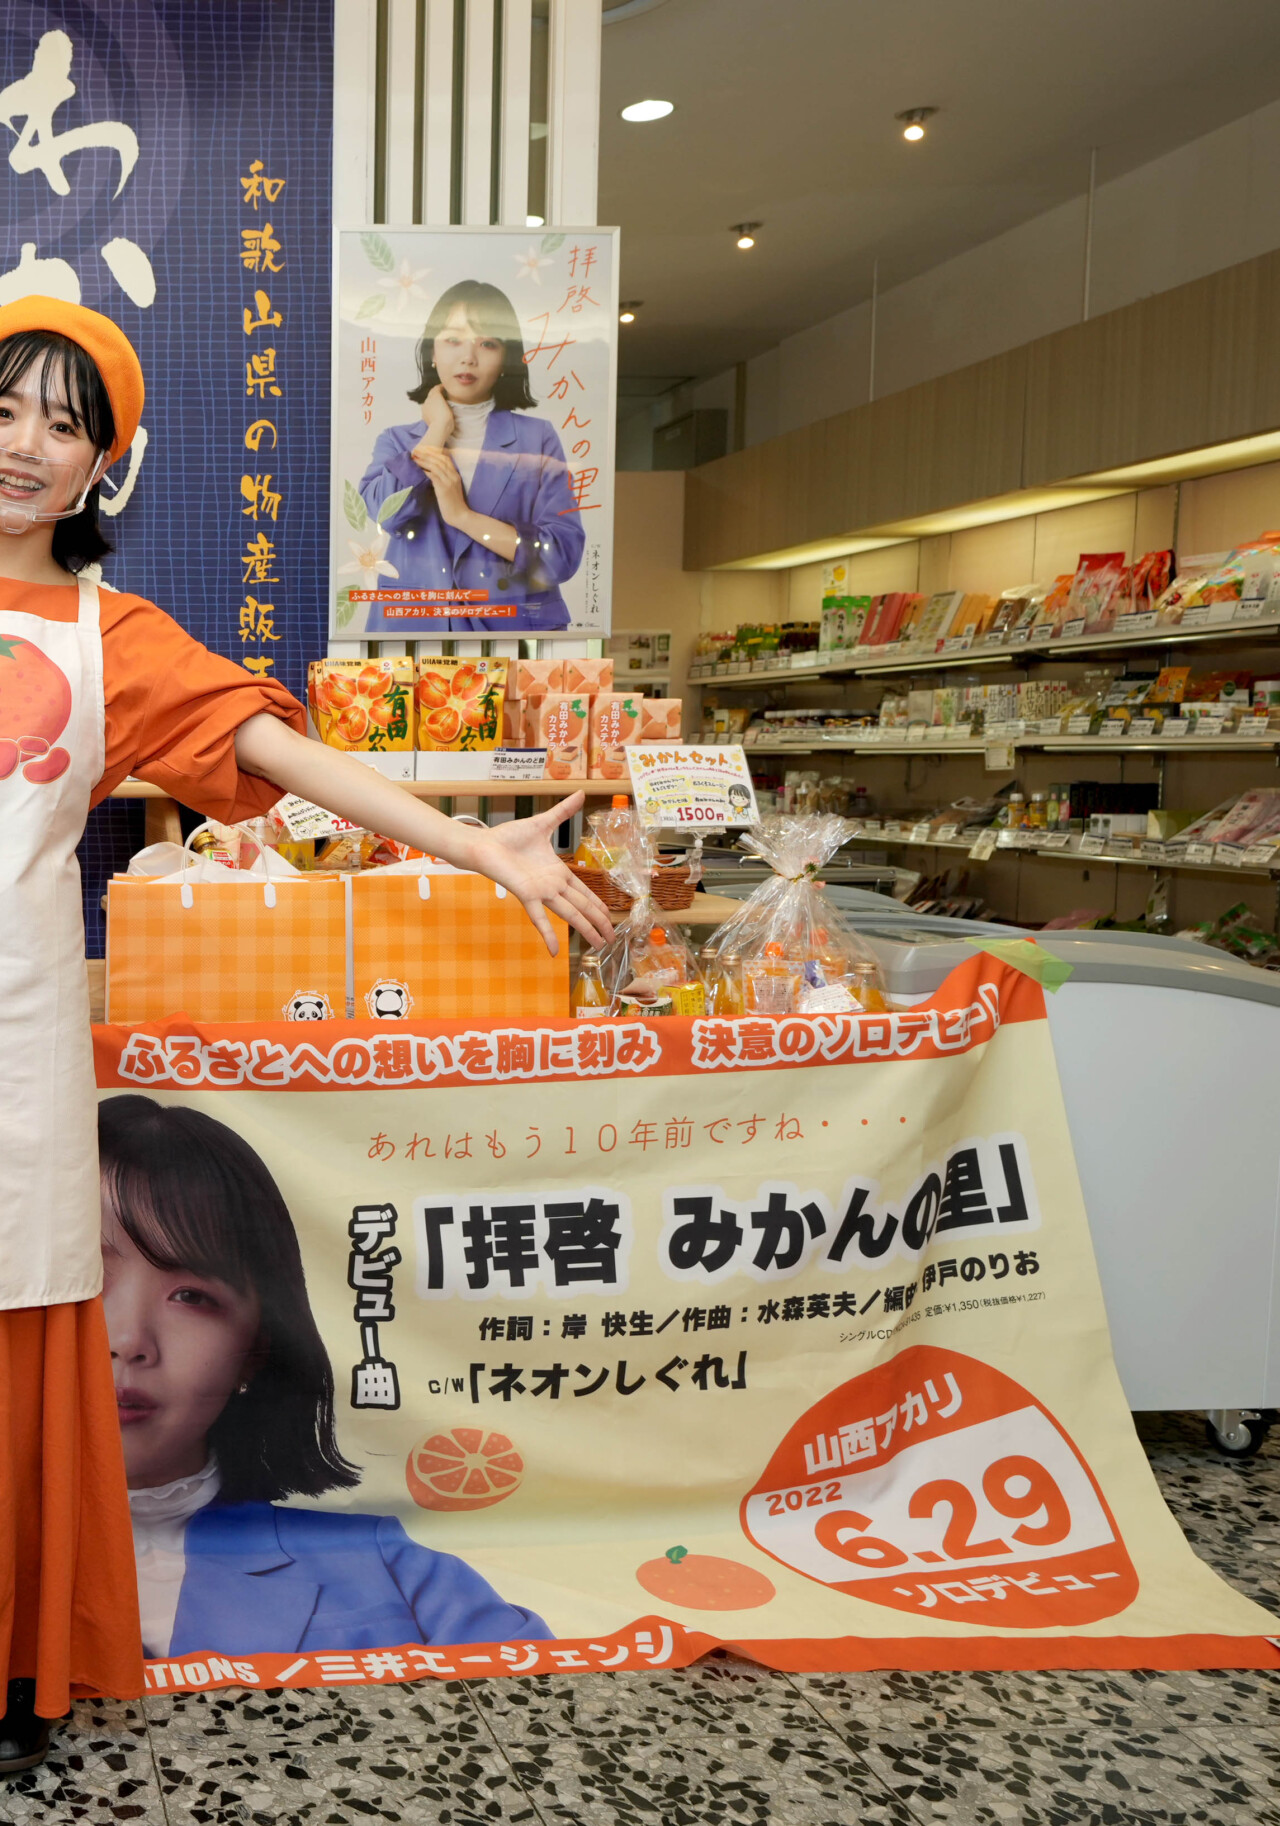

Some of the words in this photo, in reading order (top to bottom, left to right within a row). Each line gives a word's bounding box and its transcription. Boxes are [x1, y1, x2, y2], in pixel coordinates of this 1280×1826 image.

[557, 245, 601, 313] 拝啓
[360, 336, 377, 426] 山西アカリ
[522, 312, 602, 516] みかんの里
[383, 684, 409, 741] 有田
[478, 686, 499, 740] 有田
[548, 714, 557, 750] カステラ
[559, 701, 568, 747] 有田みかん
[600, 714, 609, 750] カステラ
[610, 701, 620, 747] 有田みかん
[639, 751, 729, 767] みかんセット
[676, 807, 724, 821] 1500円
[118, 1024, 661, 1088] ふるさとへの想いを胸に刻み
[348, 1202, 402, 1411] デビュー曲
[803, 1372, 963, 1475] 山西アカリ
[765, 1481, 843, 1516] 2022
[814, 1455, 1071, 1568] 6.29
[893, 1572, 1120, 1609] ソロデビュー
[275, 1625, 694, 1683] ／三井エージェンシ
